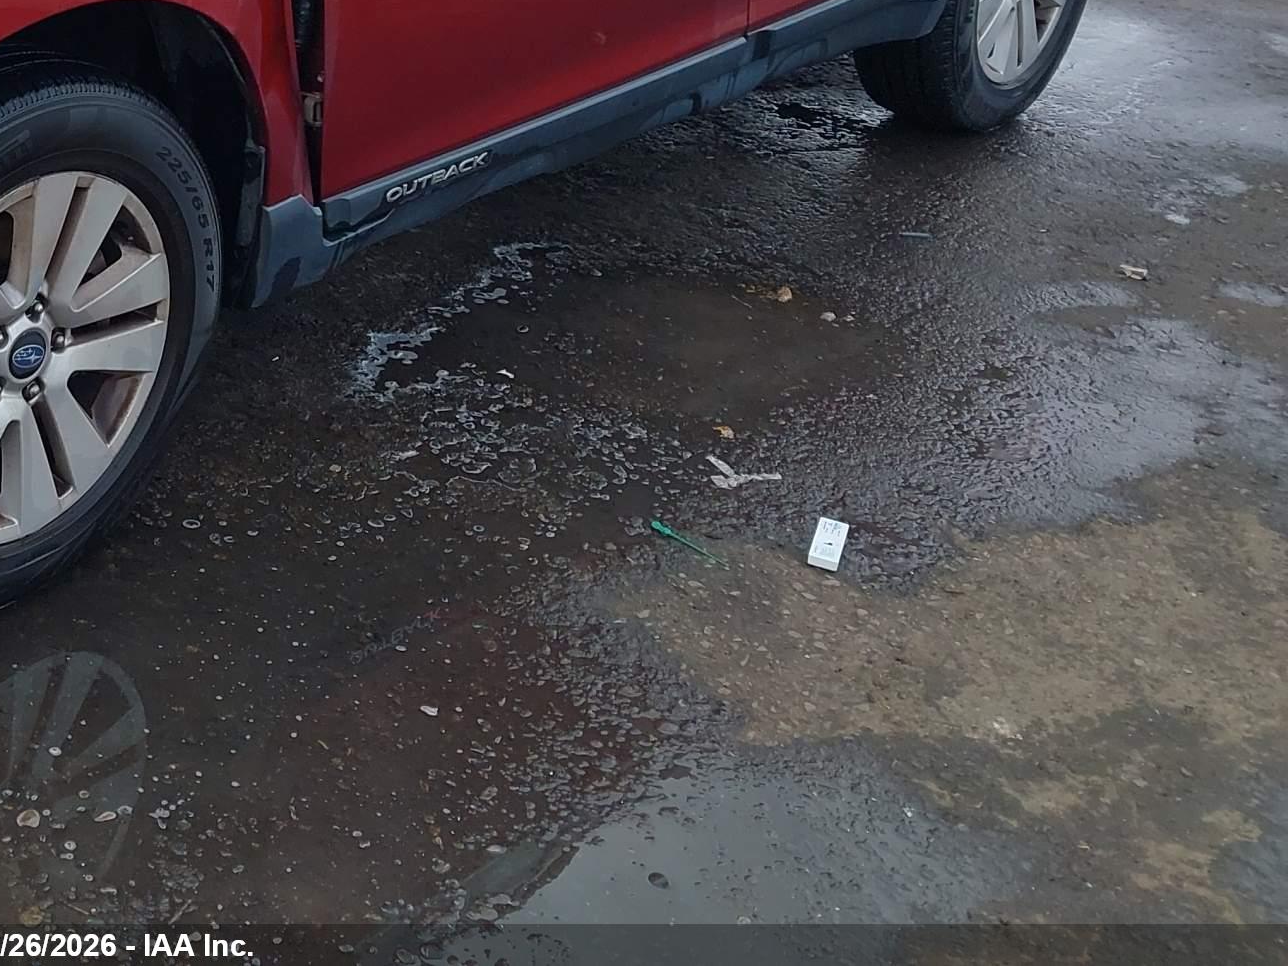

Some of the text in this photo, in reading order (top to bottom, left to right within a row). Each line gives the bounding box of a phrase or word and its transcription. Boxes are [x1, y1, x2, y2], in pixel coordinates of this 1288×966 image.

[155, 145, 215, 293] 225/65 R17
[385, 151, 488, 203] OUTBACK
